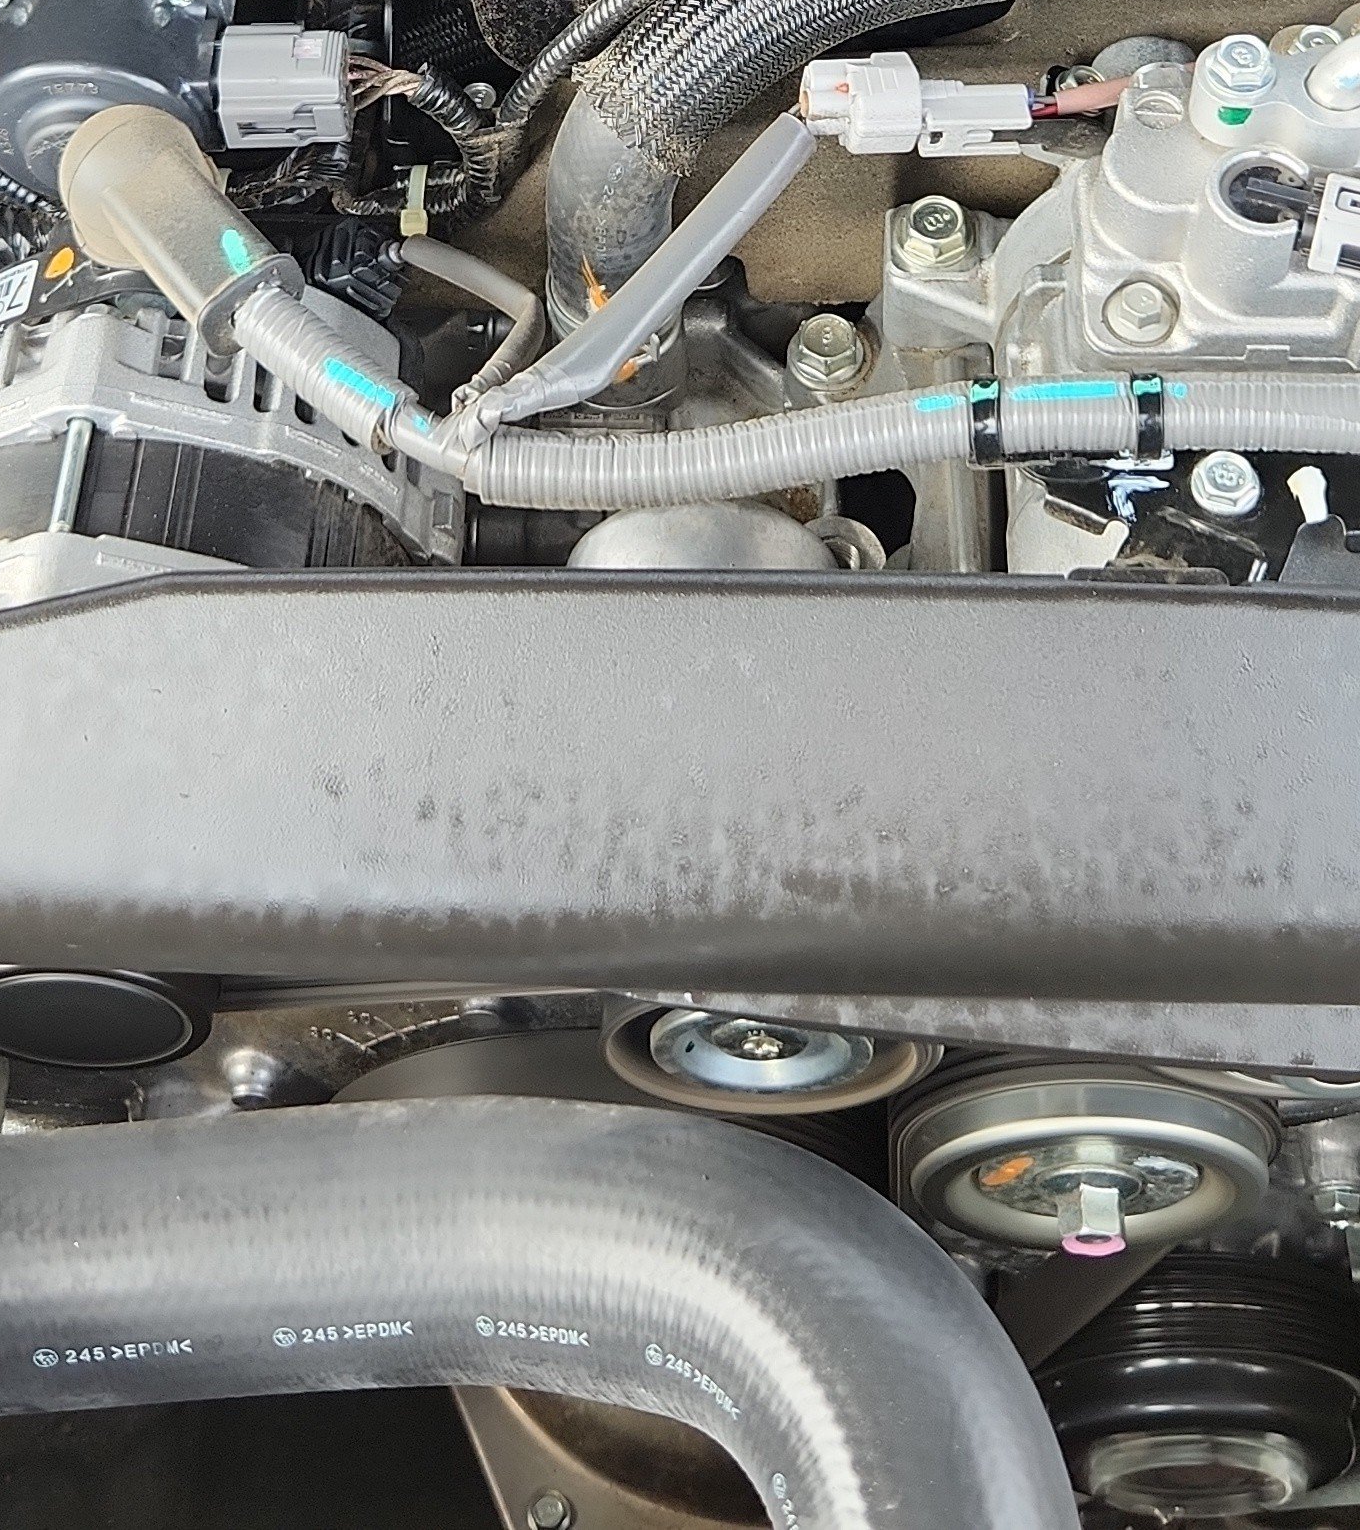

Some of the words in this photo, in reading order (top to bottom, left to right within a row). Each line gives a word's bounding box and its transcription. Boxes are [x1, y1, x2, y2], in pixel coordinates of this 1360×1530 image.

[302, 1326, 338, 1343] 245
[497, 1320, 527, 1338] 245
[65, 1346, 105, 1363] 245
[664, 1353, 692, 1378] 245
